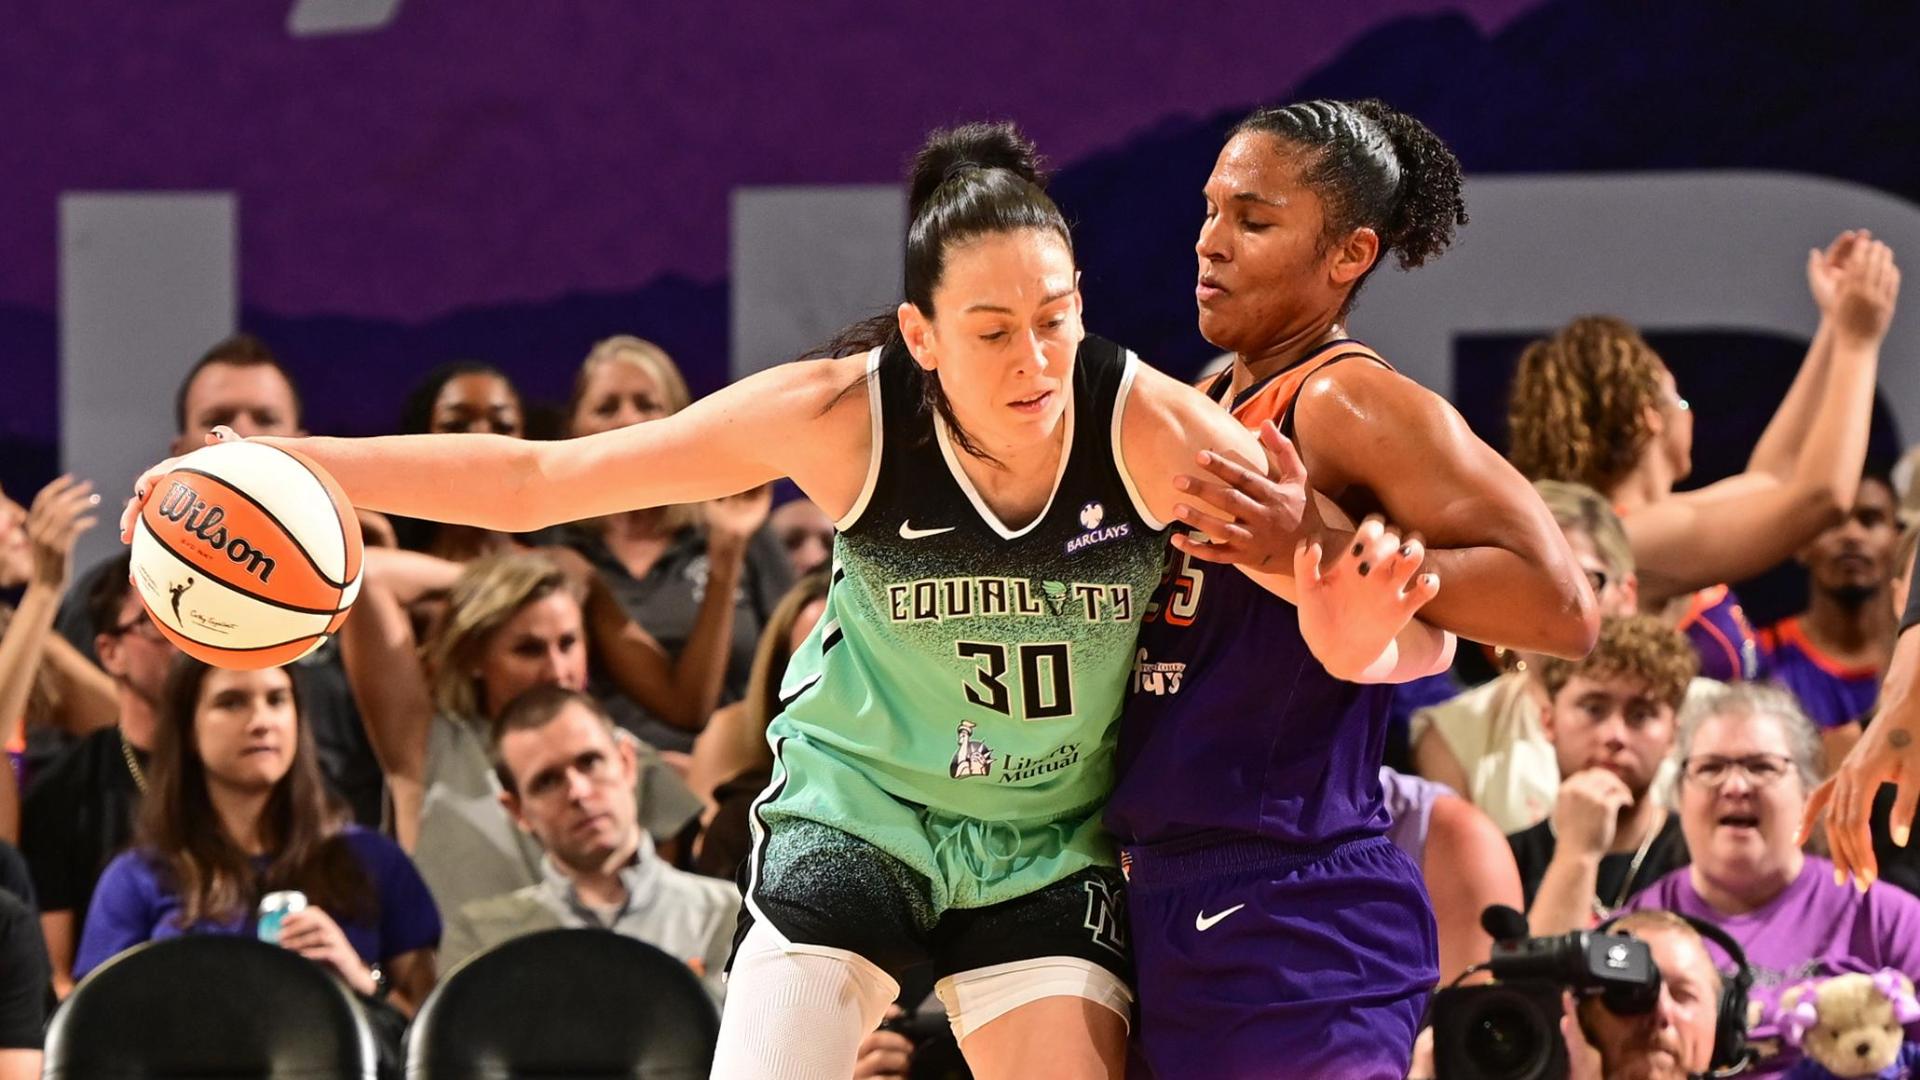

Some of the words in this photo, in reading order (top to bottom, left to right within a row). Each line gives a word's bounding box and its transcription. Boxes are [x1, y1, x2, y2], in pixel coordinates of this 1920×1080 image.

[159, 481, 276, 584] Wilson
[1067, 523, 1128, 553] BARCLAYS
[955, 640, 1075, 721] 30
[998, 752, 1079, 783] Mutual
[1002, 743, 1080, 770] Lirty
